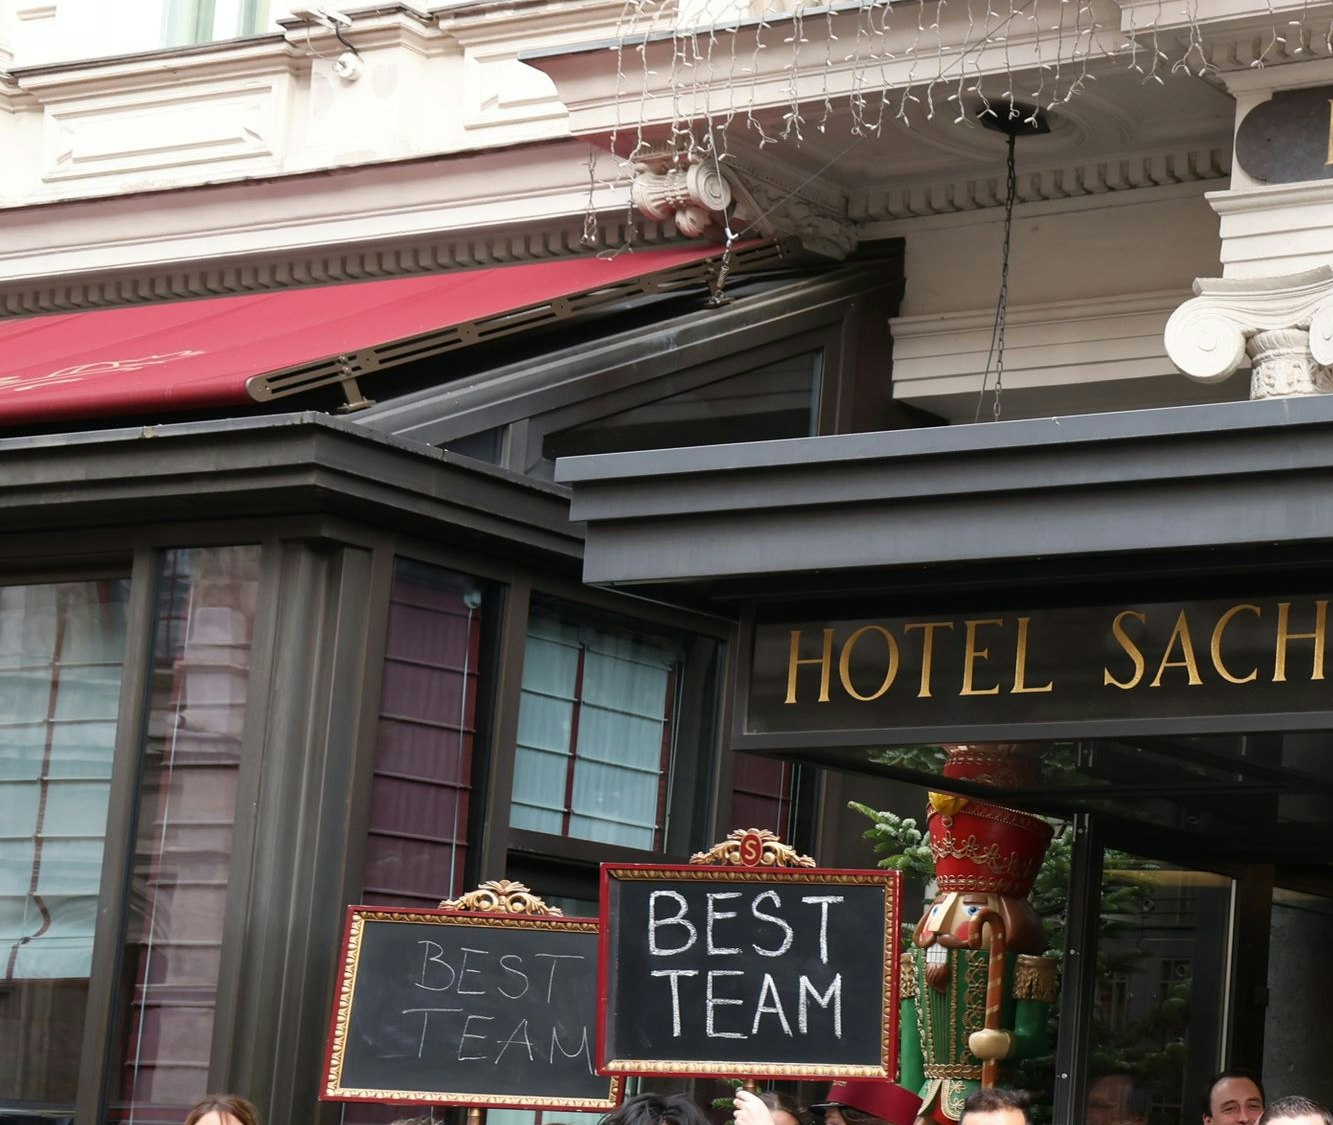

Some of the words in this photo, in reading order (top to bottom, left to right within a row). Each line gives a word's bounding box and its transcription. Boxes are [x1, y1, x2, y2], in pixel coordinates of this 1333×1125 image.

[784, 616, 1053, 704] HOTEL
[744, 840, 757, 860] S
[648, 889, 845, 965] BEST
[415, 940, 586, 1003] BEST
[650, 969, 843, 1039] TEAM
[402, 1008, 595, 1076] TEAM
